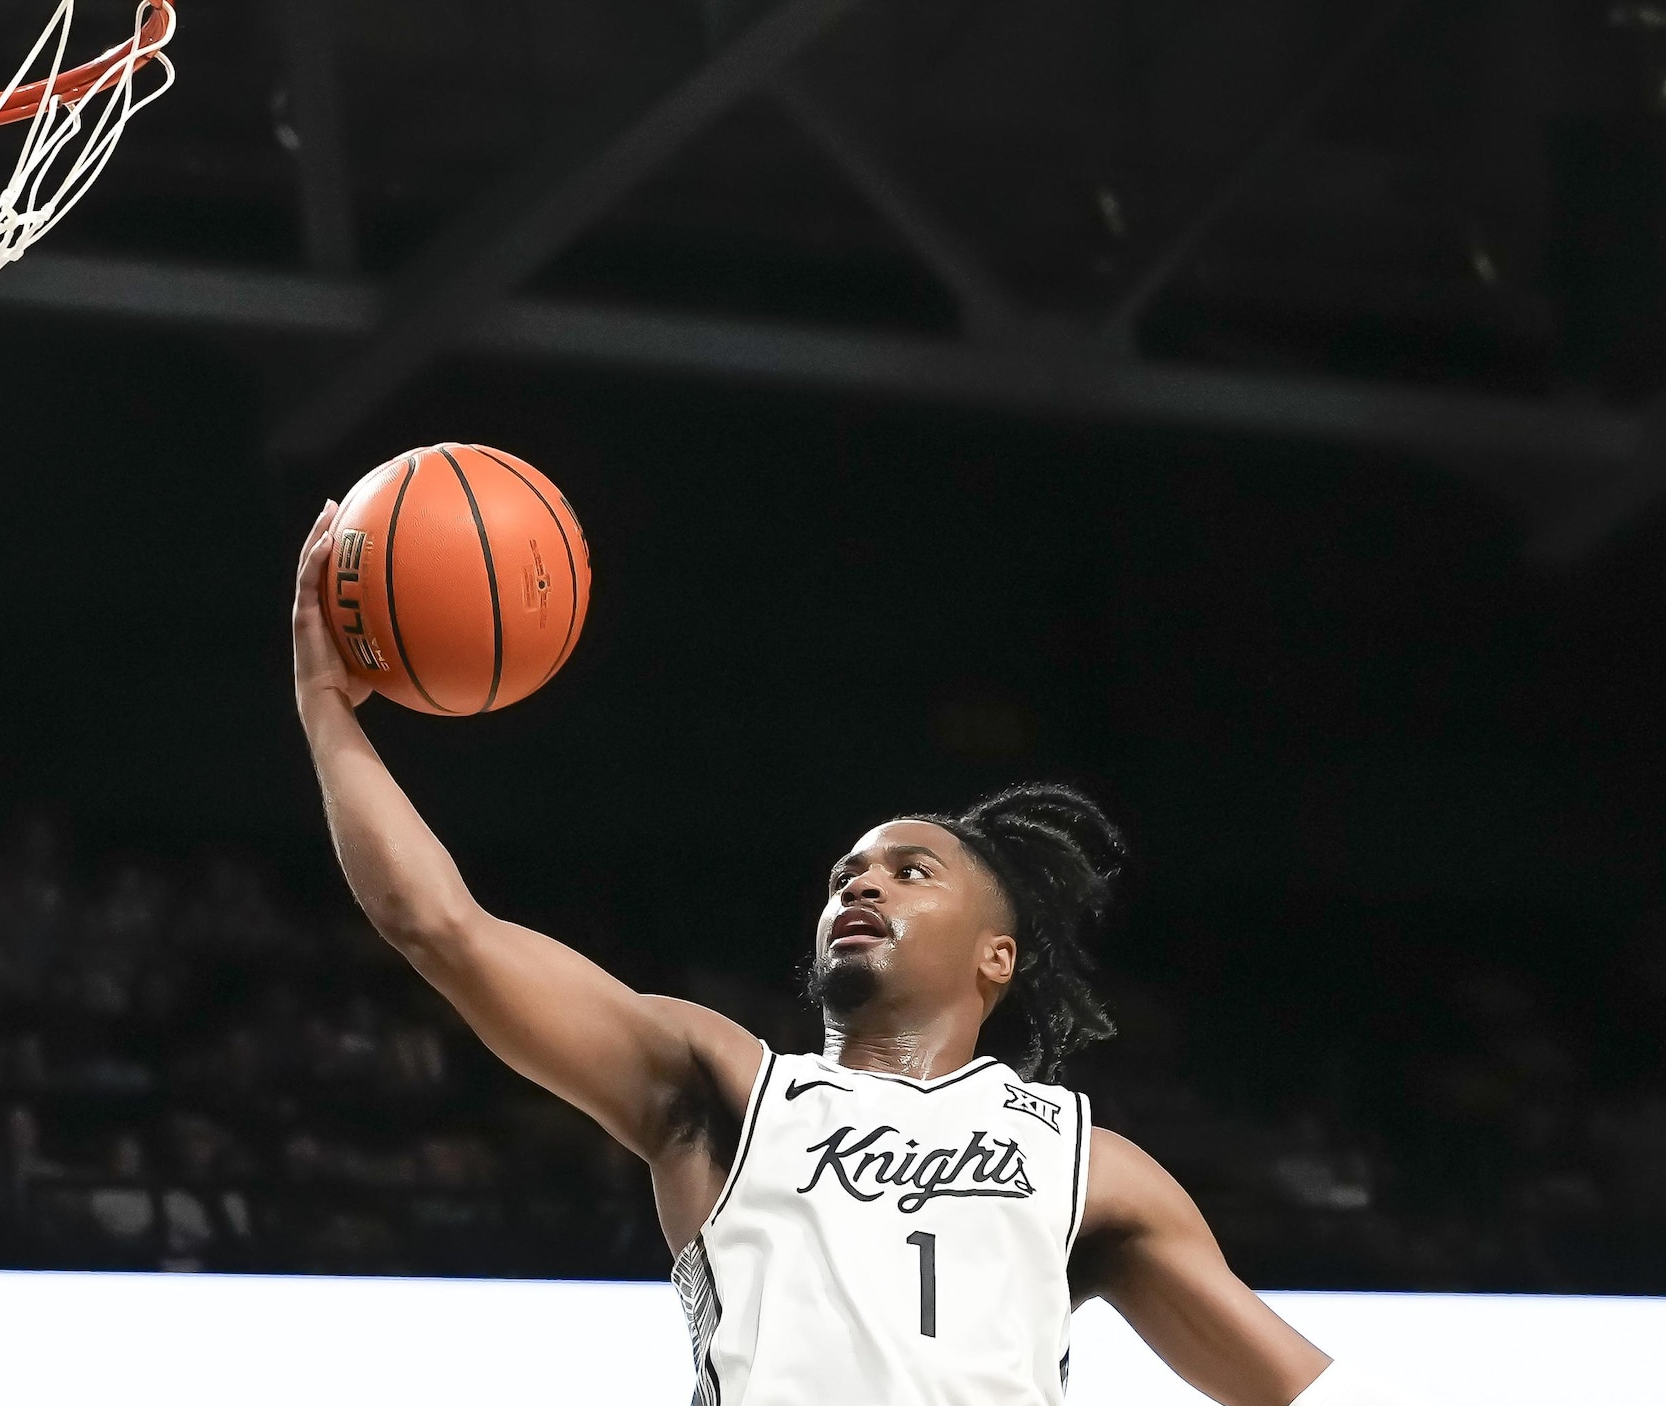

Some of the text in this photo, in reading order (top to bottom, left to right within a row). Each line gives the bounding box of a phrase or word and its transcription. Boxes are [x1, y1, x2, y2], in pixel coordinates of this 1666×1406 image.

[336, 527, 381, 671] ELITE
[796, 1125, 1037, 1214] Knights
[906, 1230, 936, 1338] 1
